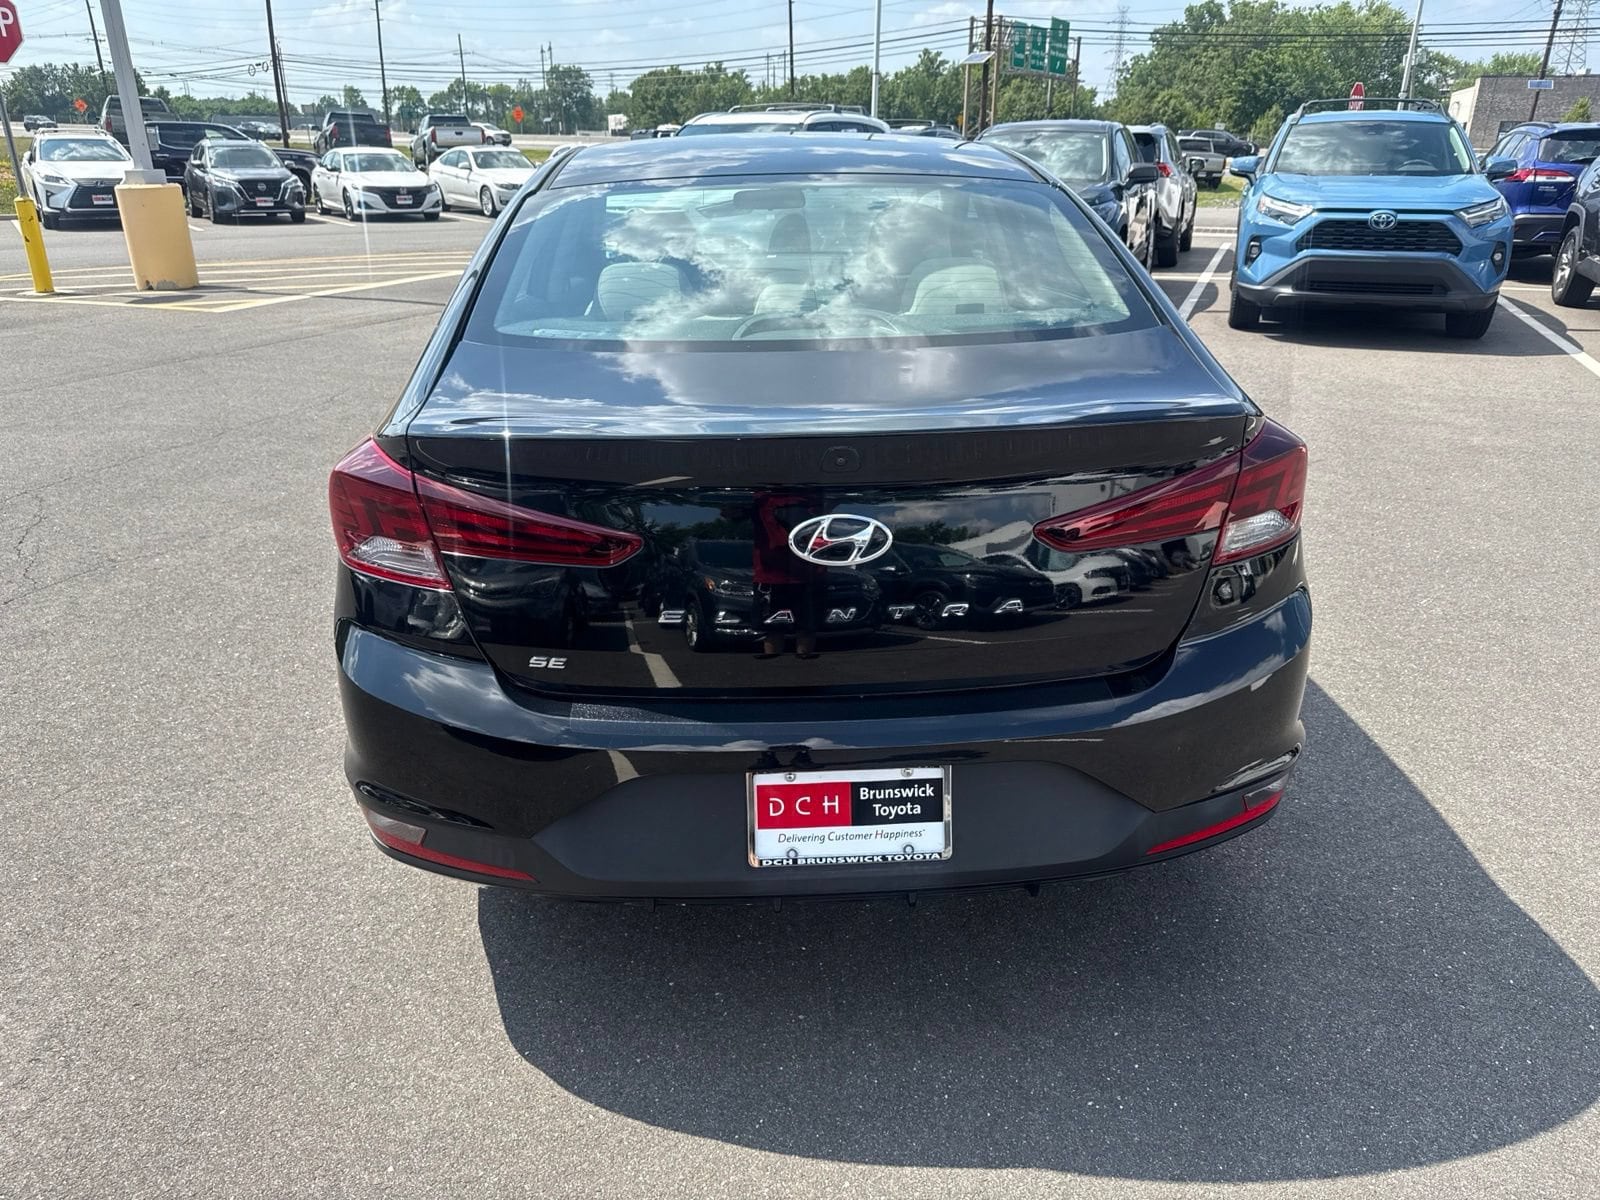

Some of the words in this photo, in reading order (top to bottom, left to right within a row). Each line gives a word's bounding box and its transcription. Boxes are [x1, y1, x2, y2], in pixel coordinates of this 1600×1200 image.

[658, 600, 1023, 623] ELANTRA
[528, 656, 567, 669] SE
[860, 784, 934, 800] Brunswick
[873, 803, 921, 819] Toyota
[778, 833, 825, 844] Delivering
[828, 831, 872, 842] Customer
[762, 858, 793, 866] DCH
[797, 854, 884, 865] BRUNSWICK
[886, 852, 941, 861] TOYOTA
